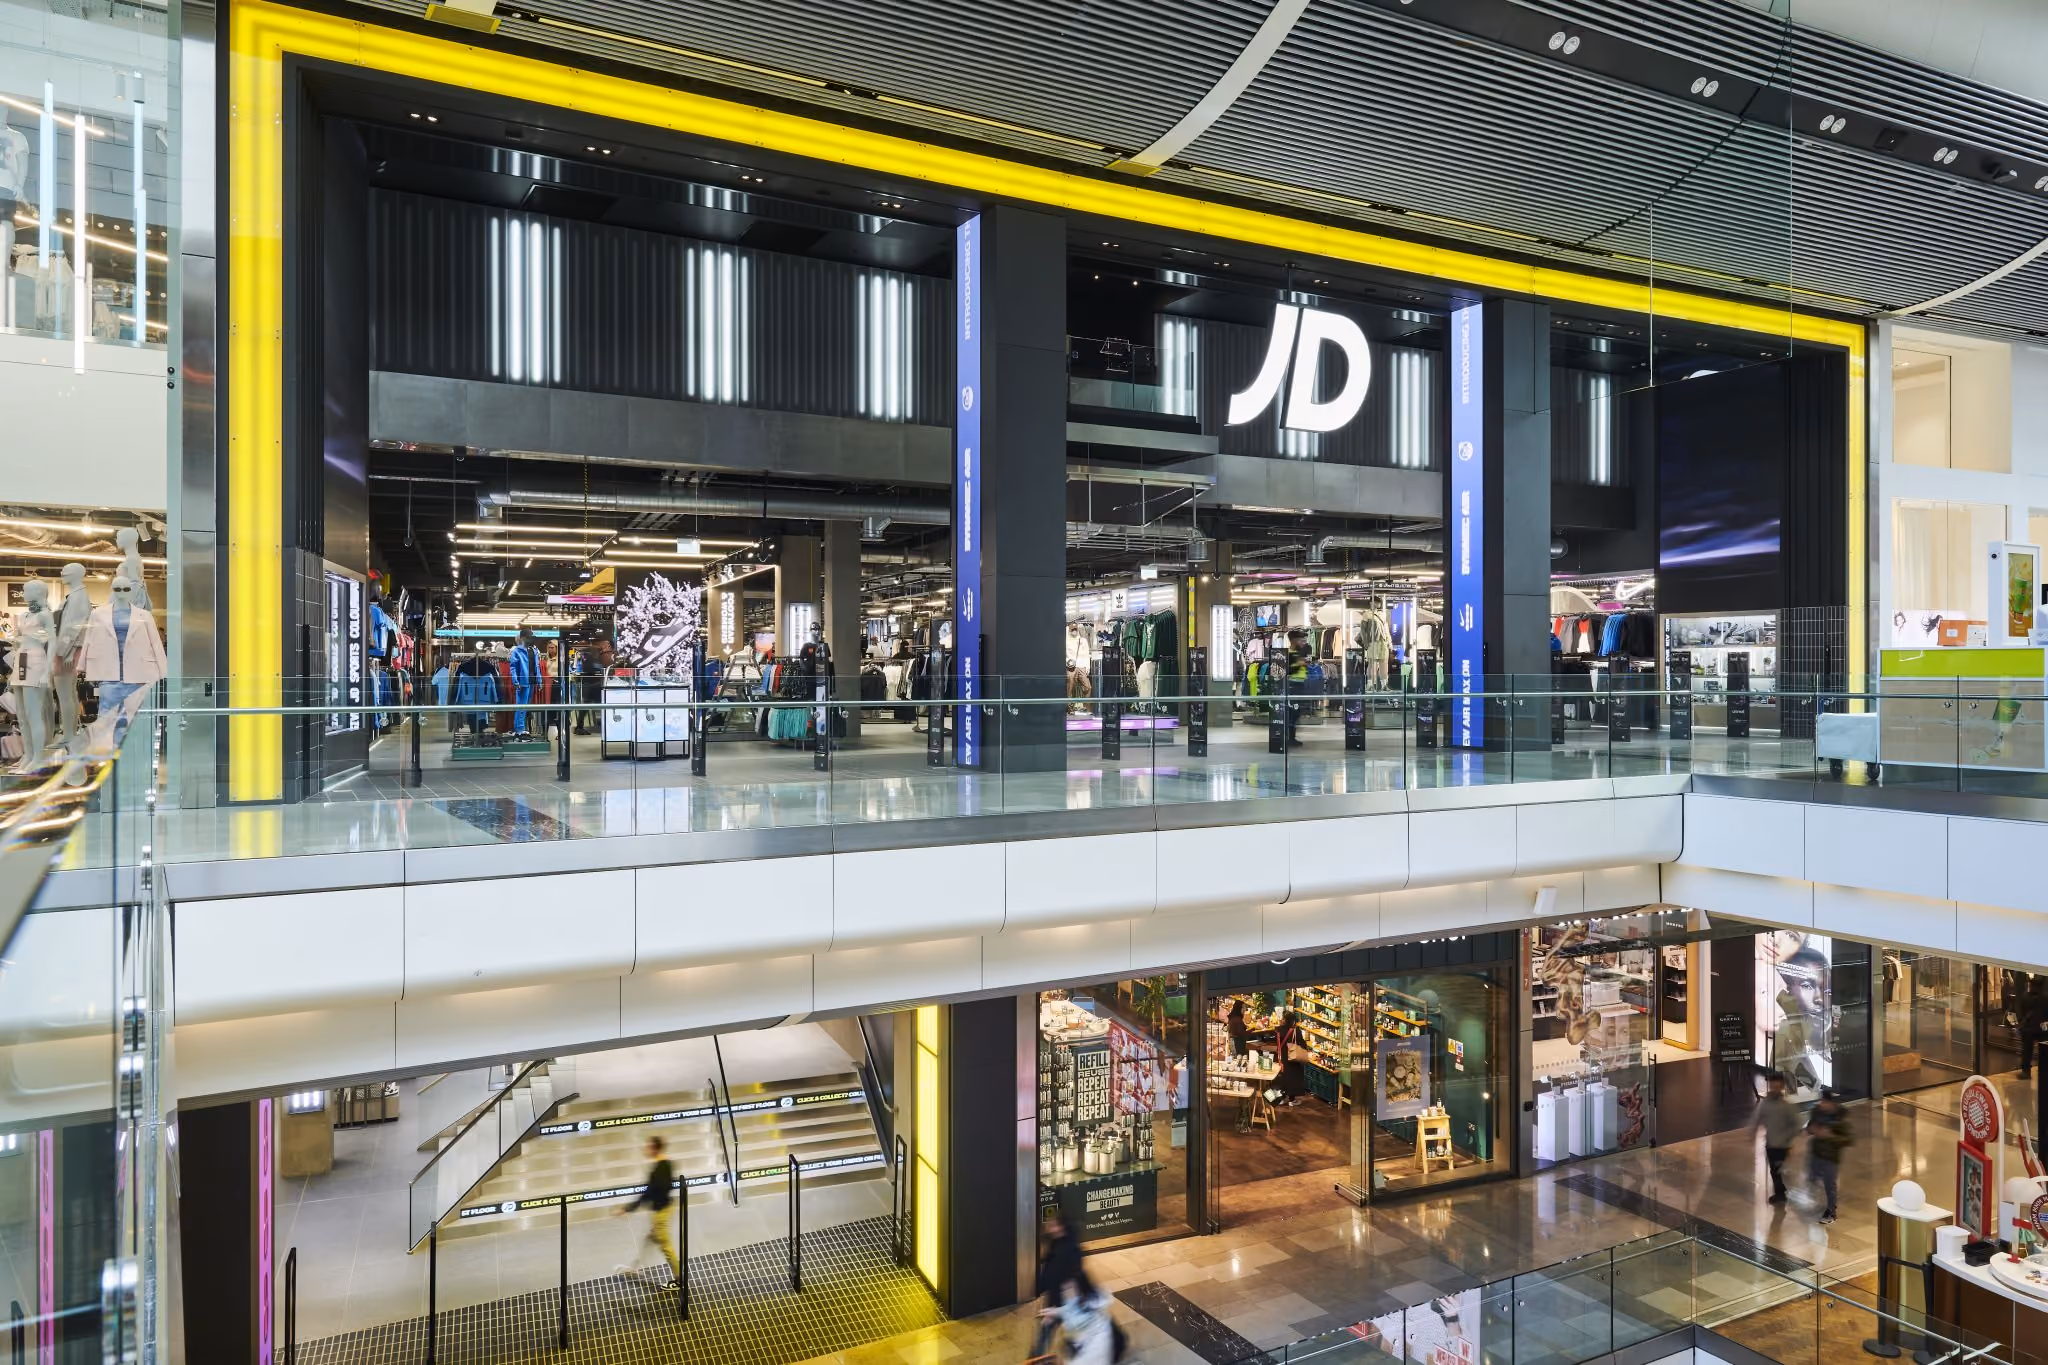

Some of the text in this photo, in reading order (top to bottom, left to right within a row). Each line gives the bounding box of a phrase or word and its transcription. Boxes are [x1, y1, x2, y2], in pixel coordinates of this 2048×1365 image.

[1228, 303, 1372, 432] JD
[350, 642, 360, 683] SPORTS
[1462, 707, 1471, 728] AIR
[1079, 1050, 1109, 1069] REFILL
[1078, 1068, 1110, 1078] REUSE
[1078, 1075, 1109, 1092] REPEAT
[1078, 1088, 1109, 1107] REPEAT
[1078, 1103, 1110, 1121] REPEAT
[1086, 1184, 1133, 1202] CHANGEMAKING
[1100, 1198, 1120, 1209] BEAUTY
